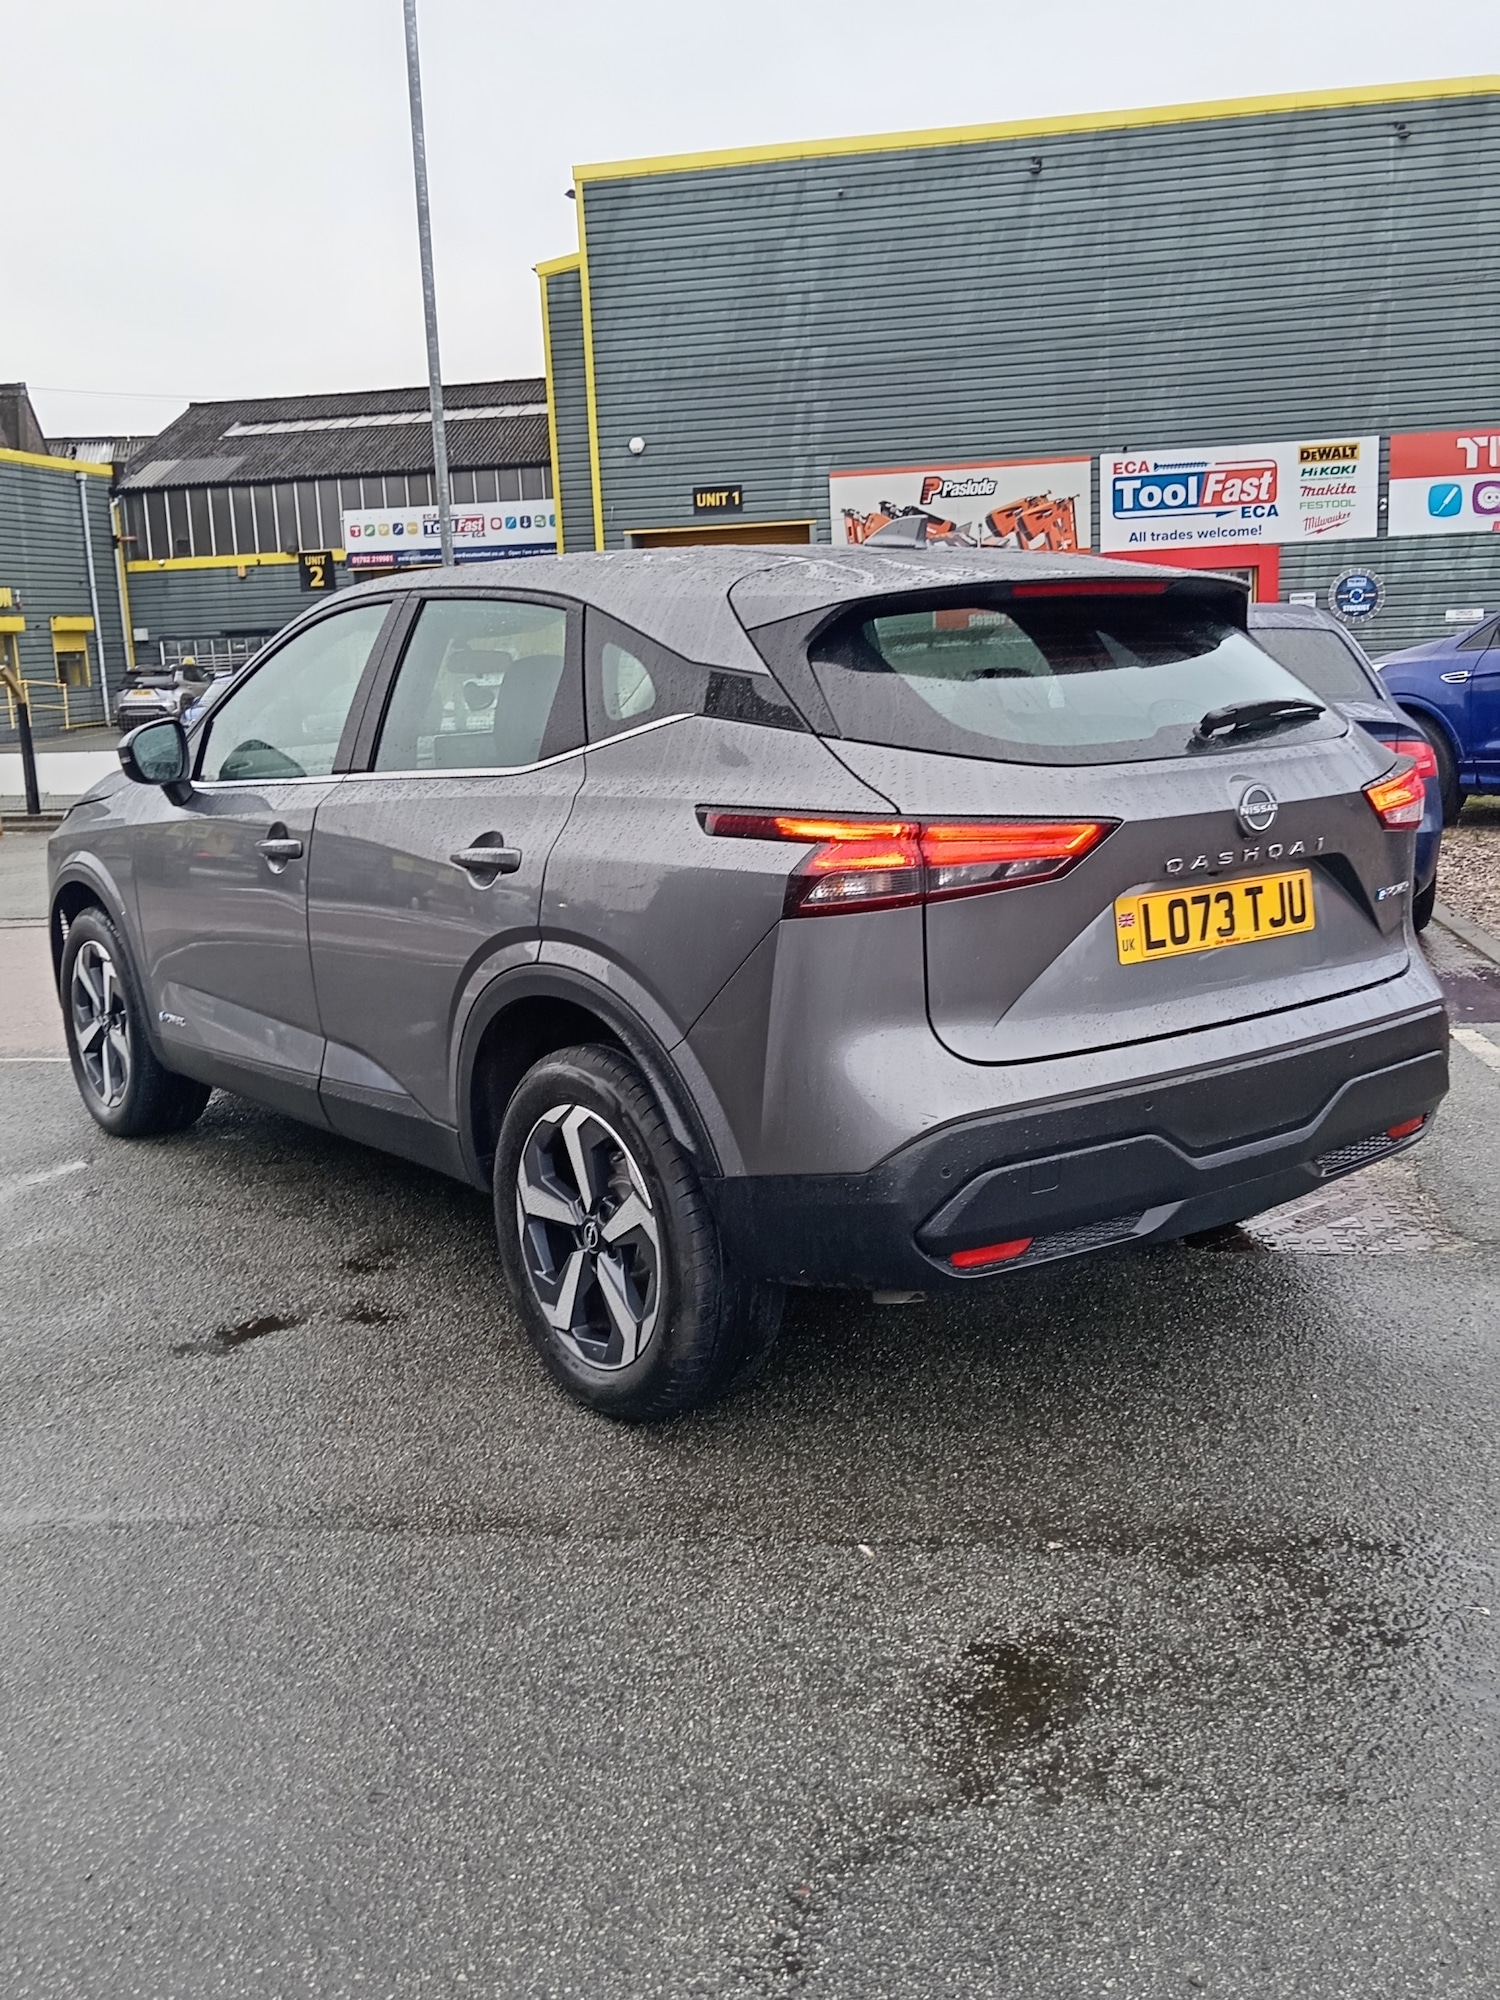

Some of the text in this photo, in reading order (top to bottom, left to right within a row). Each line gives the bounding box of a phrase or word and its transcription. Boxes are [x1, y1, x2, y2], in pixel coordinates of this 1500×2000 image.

[1113, 461, 1150, 475] ECA
[941, 478, 997, 498] Paslode
[696, 491, 740, 507] UNIT 1
[1299, 499, 1356, 510] FESTOOL
[1241, 504, 1279, 519] ECA
[424, 520, 456, 534] Tol
[1129, 525, 1263, 543] All trades welcome!
[304, 555, 326, 587] UNIT 2
[1240, 803, 1278, 816] NISSAN
[1166, 836, 1325, 876] QASHQAI
[1245, 879, 1307, 932] TJU
[1122, 938, 1136, 952] UK
